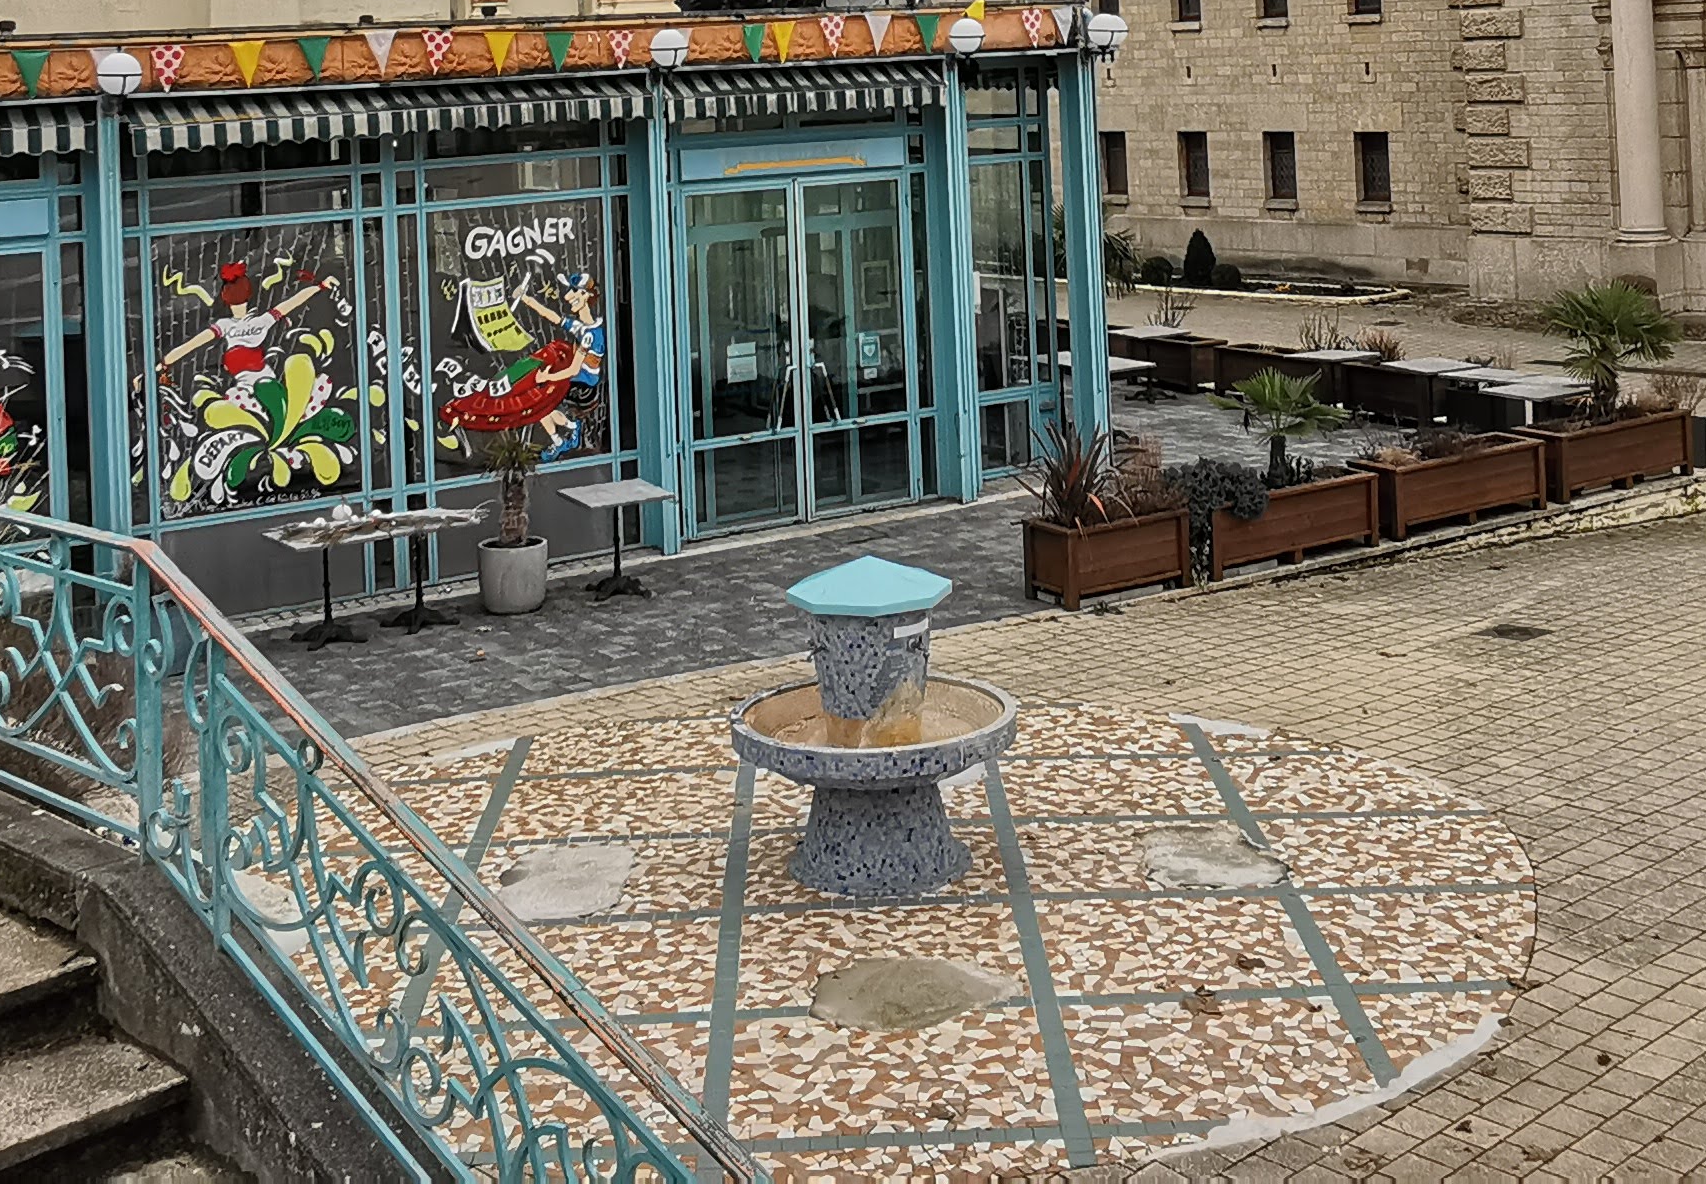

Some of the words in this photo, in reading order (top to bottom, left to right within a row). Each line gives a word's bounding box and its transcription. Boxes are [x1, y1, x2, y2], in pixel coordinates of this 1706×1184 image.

[465, 216, 575, 260] GAGNER
[442, 360, 458, 373] 10
[457, 384, 467, 396] 6
[491, 381, 507, 395] 31
[198, 431, 245, 469] DÉPART
